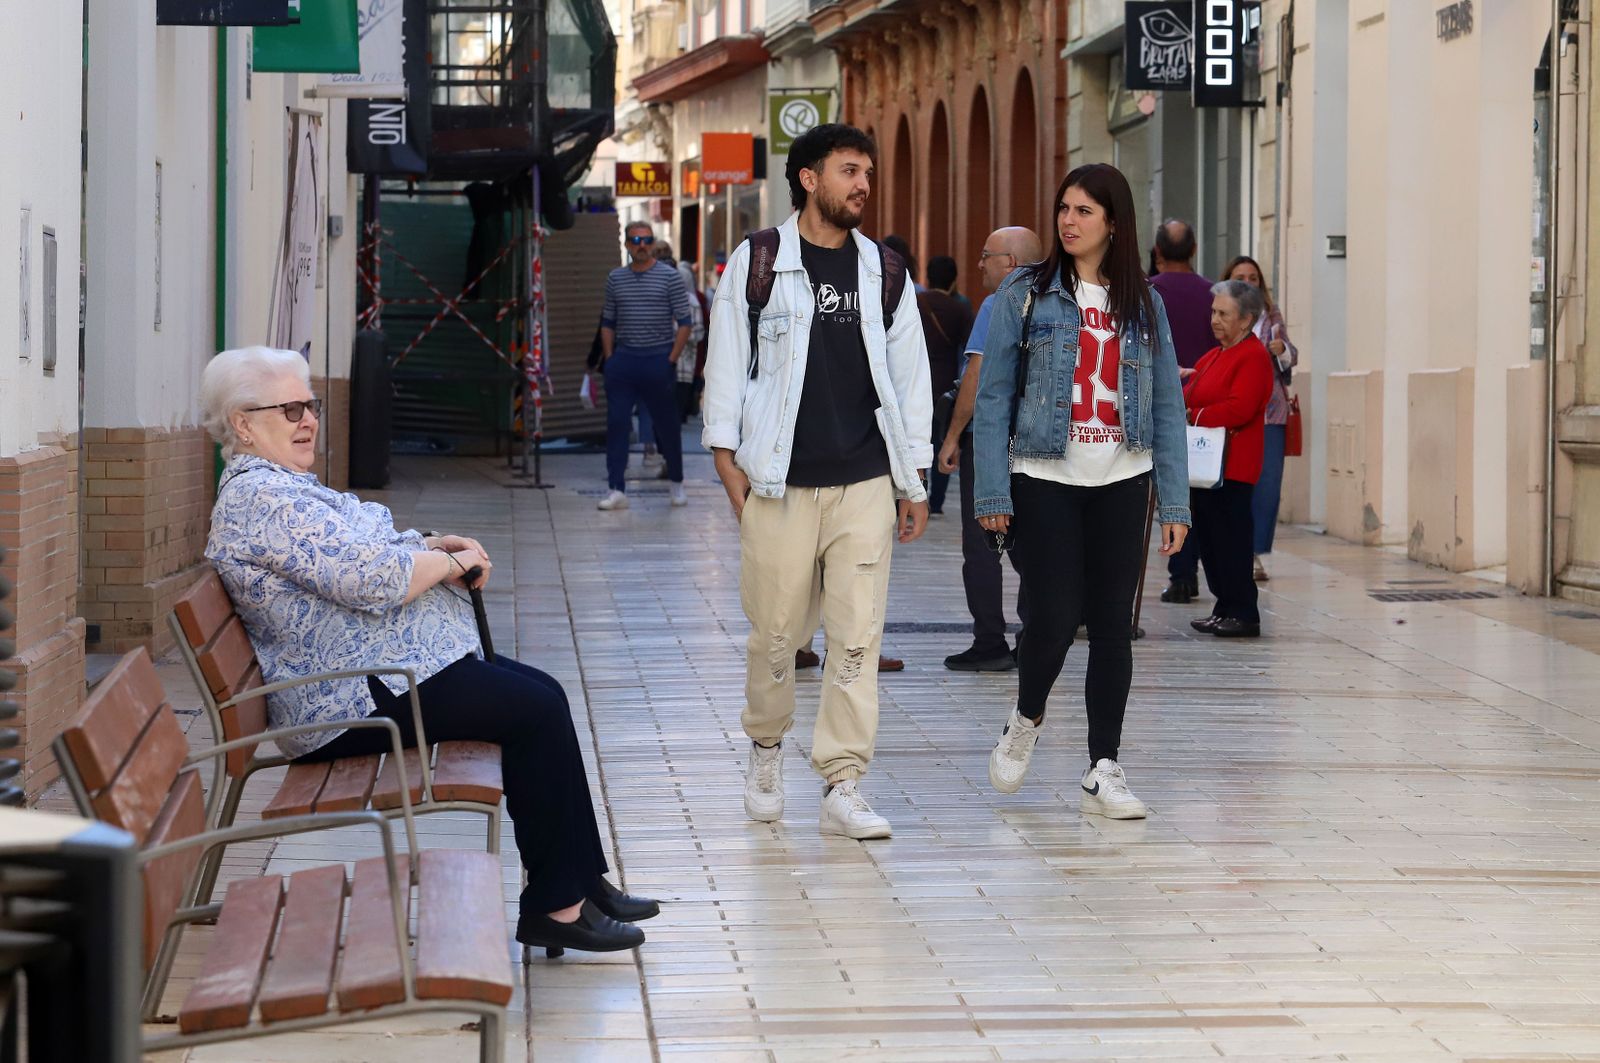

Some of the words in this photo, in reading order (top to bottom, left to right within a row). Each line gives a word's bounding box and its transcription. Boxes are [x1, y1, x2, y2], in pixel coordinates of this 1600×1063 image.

[368, 98, 406, 144] NTO
[704, 170, 749, 182] orange
[617, 181, 670, 194] TABACOS
[1077, 426, 1101, 434] YOUR
[1092, 434, 1110, 443] NOT
